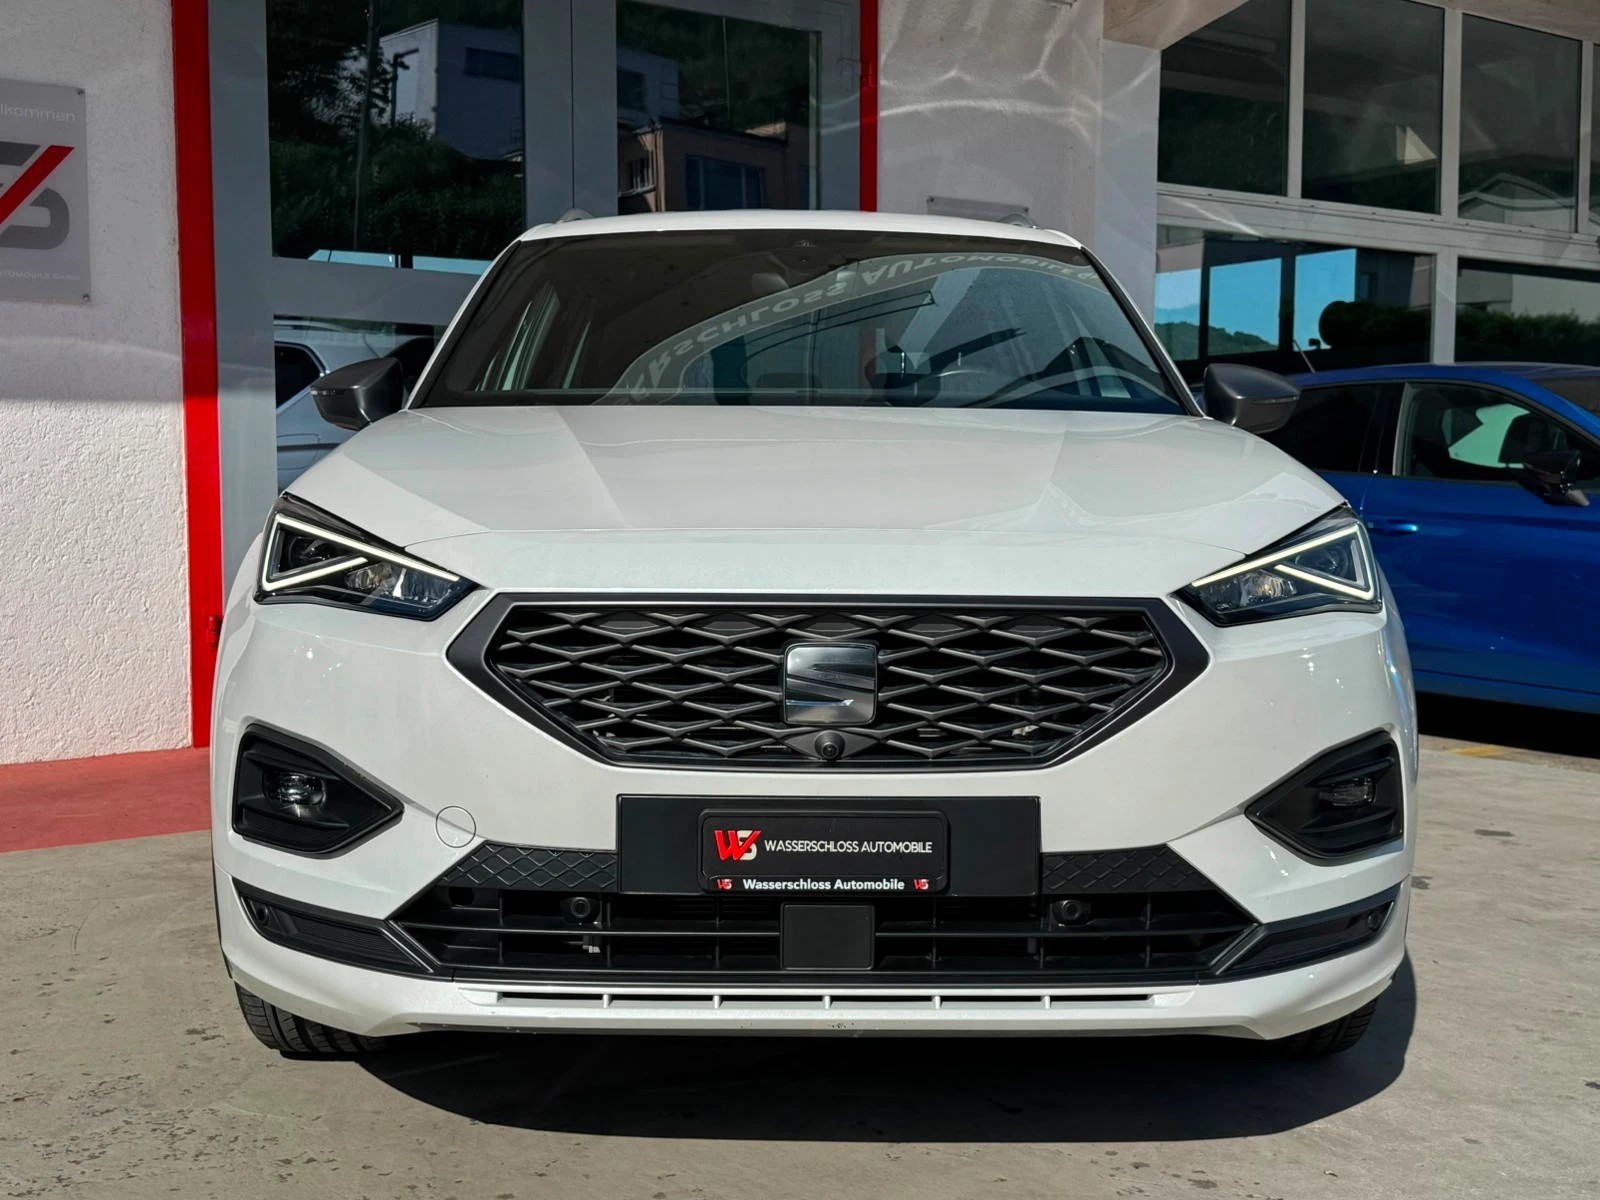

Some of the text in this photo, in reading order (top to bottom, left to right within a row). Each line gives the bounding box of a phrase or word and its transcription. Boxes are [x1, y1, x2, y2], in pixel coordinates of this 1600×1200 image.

[764, 840, 859, 853] WASSERSCHLOSS
[861, 841, 933, 853] AUTOMOBILE
[742, 878, 831, 890] Wasserschloss
[833, 878, 905, 890] Automobile
